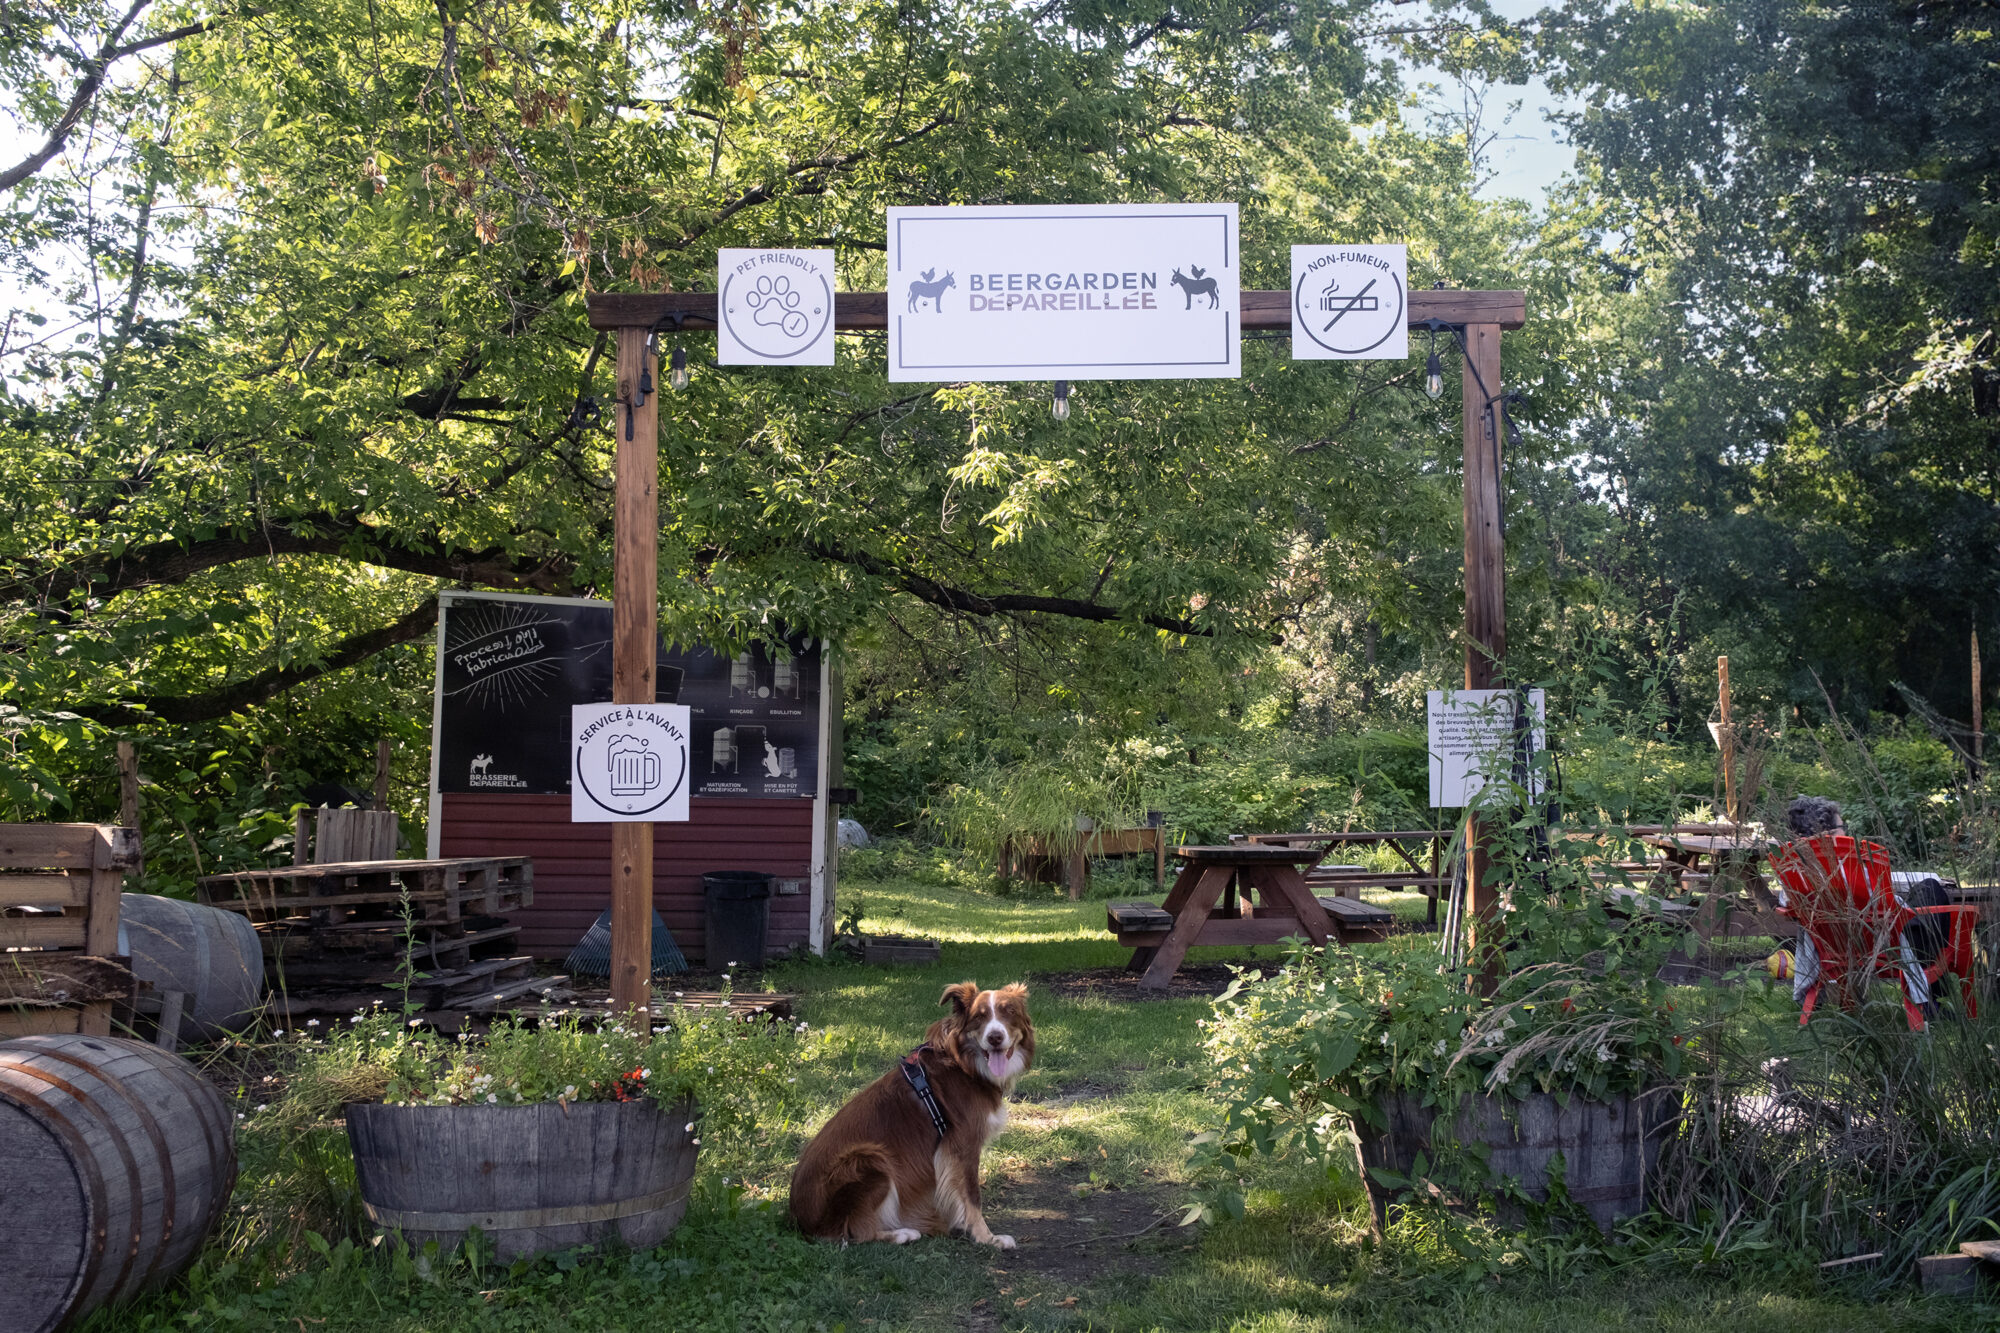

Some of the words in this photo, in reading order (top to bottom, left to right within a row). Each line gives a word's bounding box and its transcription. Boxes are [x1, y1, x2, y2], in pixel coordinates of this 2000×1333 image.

[736, 257, 757, 275] PET
[759, 253, 818, 275] FRIENDLY
[1307, 252, 1390, 273] NON-FUMEUR
[969, 272, 1157, 291] BEERGARDEN
[579, 710, 623, 744] SERVICE
[625, 707, 634, 720] À
[637, 709, 684, 742] L'AVANT
